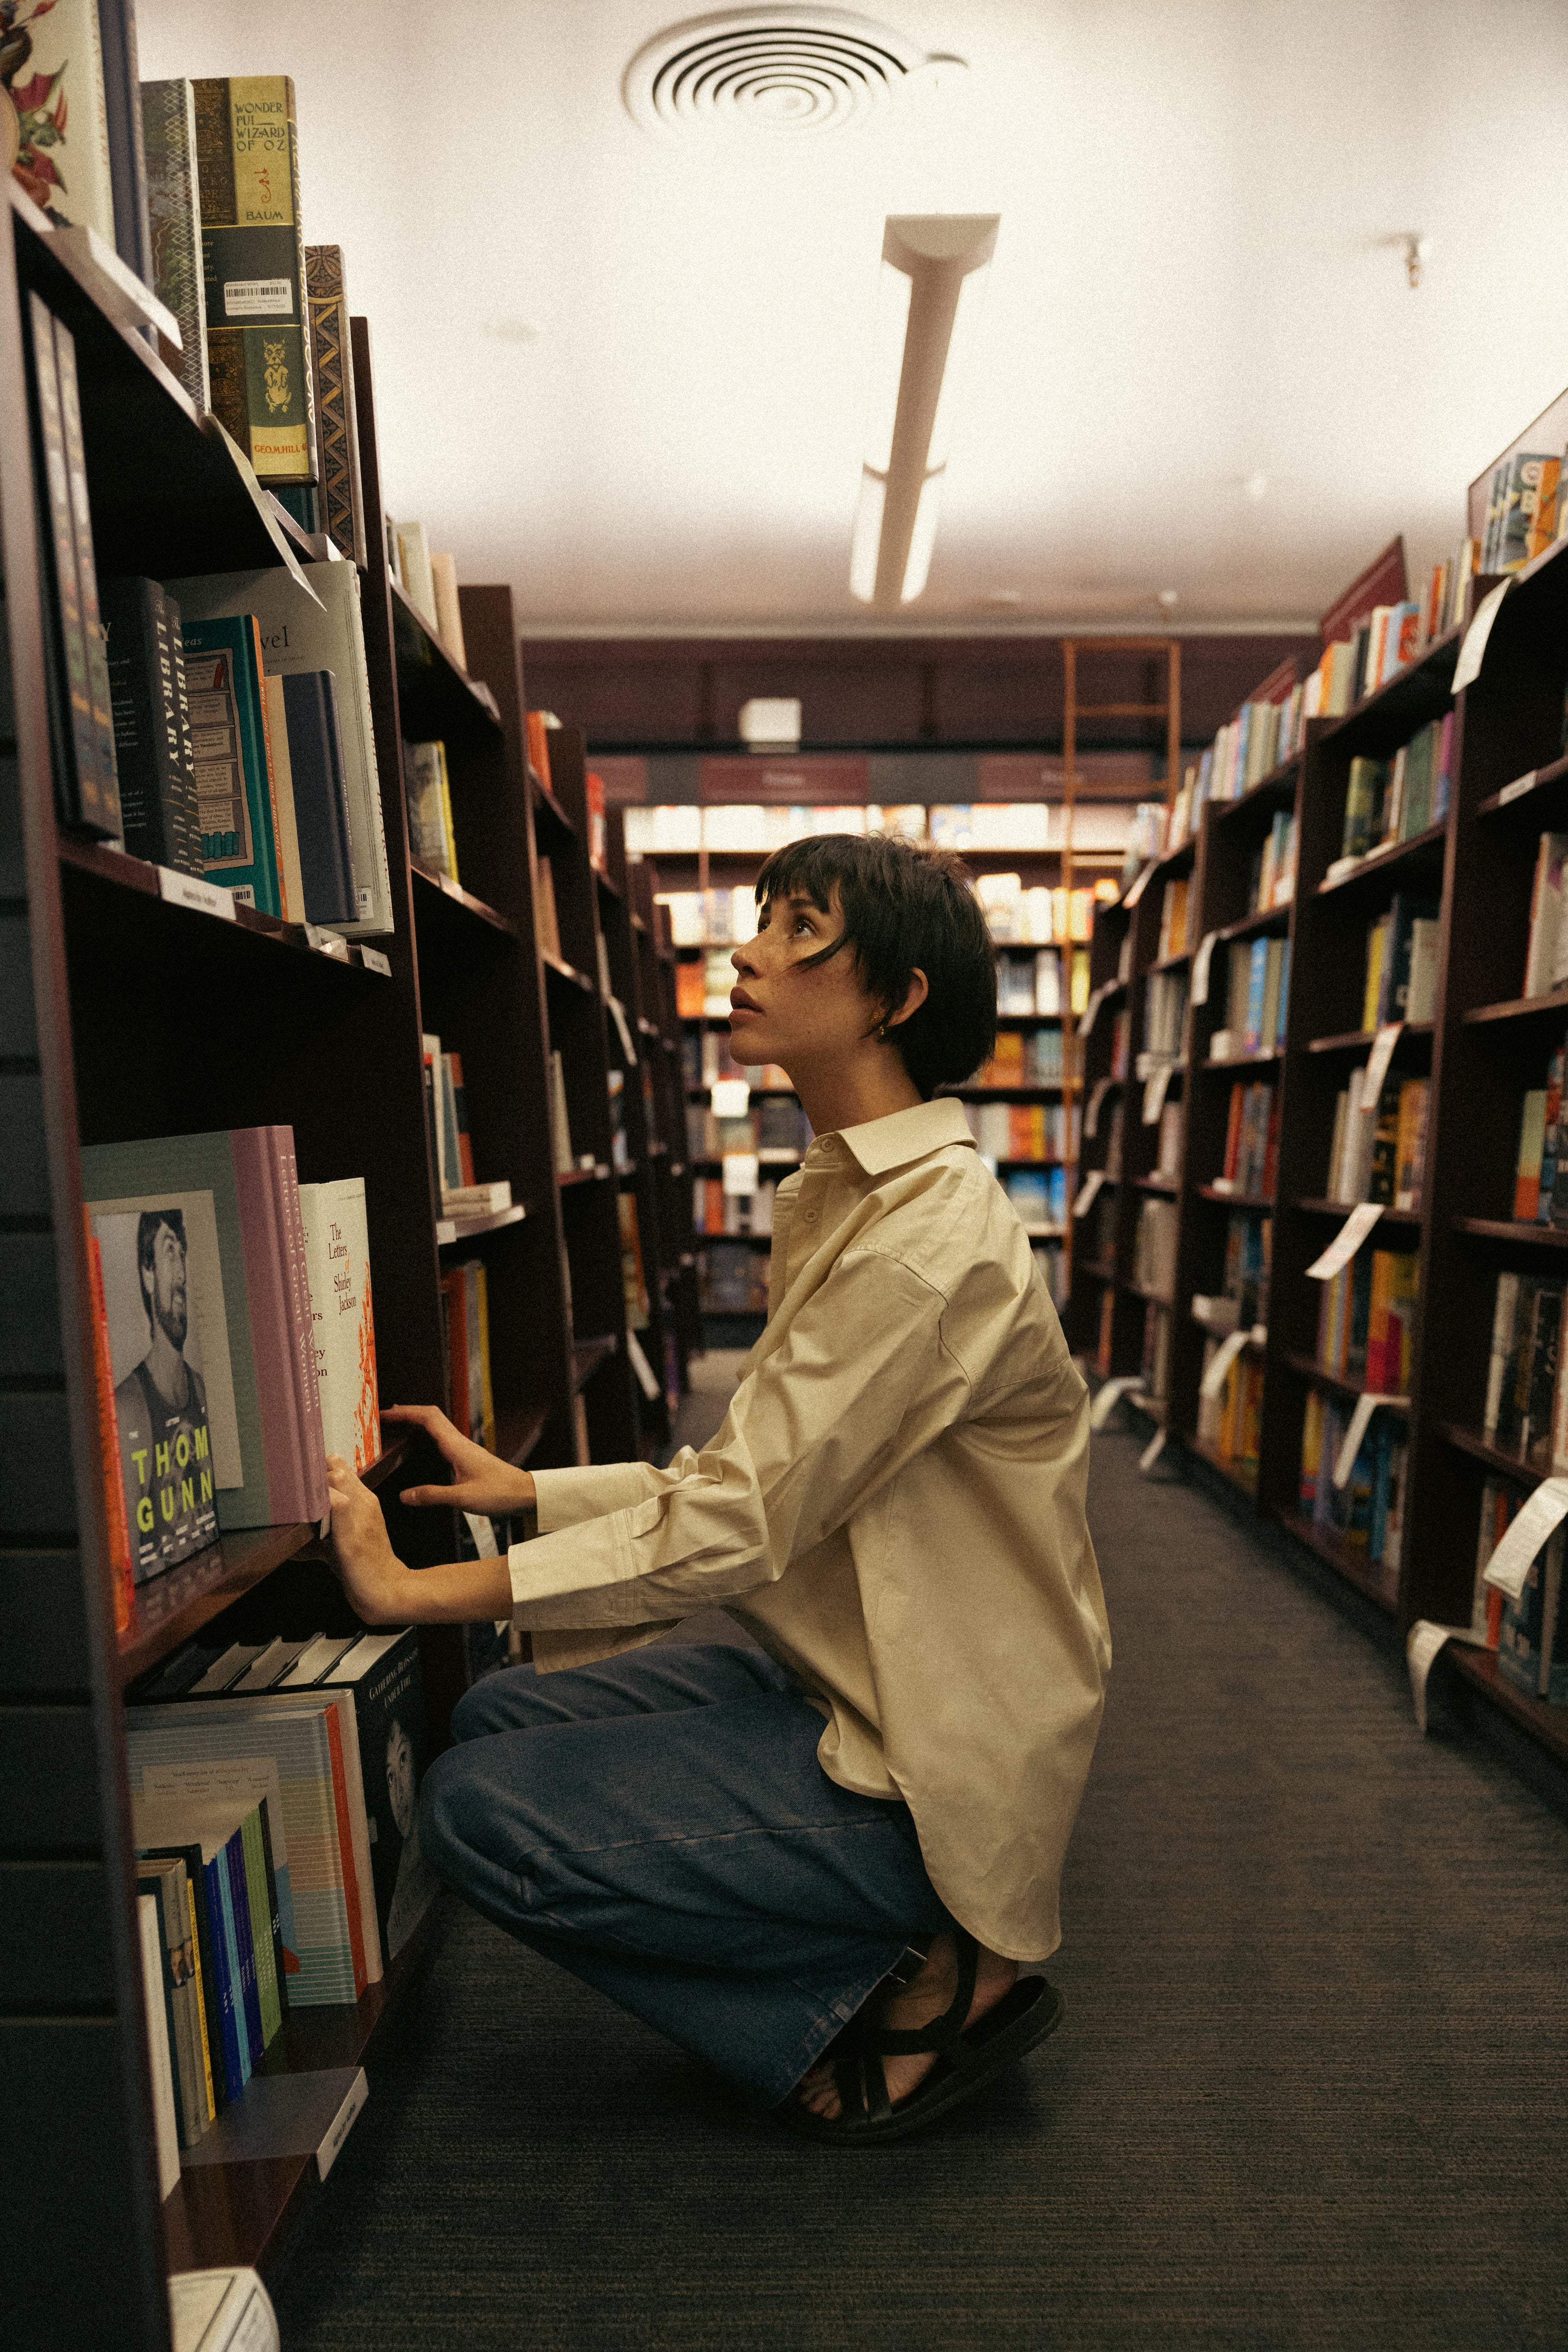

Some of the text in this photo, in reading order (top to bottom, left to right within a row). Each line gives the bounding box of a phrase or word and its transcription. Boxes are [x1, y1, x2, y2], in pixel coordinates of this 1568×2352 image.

[235, 102, 283, 113] WONDER
[236, 127, 285, 138] WIZARD
[237, 140, 286, 151] OF OZ
[246, 211, 284, 220] BAUM
[184, 637, 202, 646] eas
[260, 625, 290, 650] vel
[156, 621, 180, 766] LIBRARY
[173, 637, 195, 778] LIBRARY
[271, 804, 281, 857] BOOKSHELF
[330, 1223, 342, 1241] The
[329, 1243, 347, 1260] Letters
[345, 1252, 350, 1274] of
[280, 1155, 312, 1412] Letters of Great Women
[290, 1154, 300, 1225] Letters
[297, 1232, 305, 1251] of
[301, 1261, 311, 1318] Great
[308, 1328, 319, 1408] Women
[334, 1271, 352, 1293] Shirley
[339, 1294, 357, 1316] Jackson
[130, 1425, 210, 1484] THOM
[136, 1469, 214, 1533] GUNN
